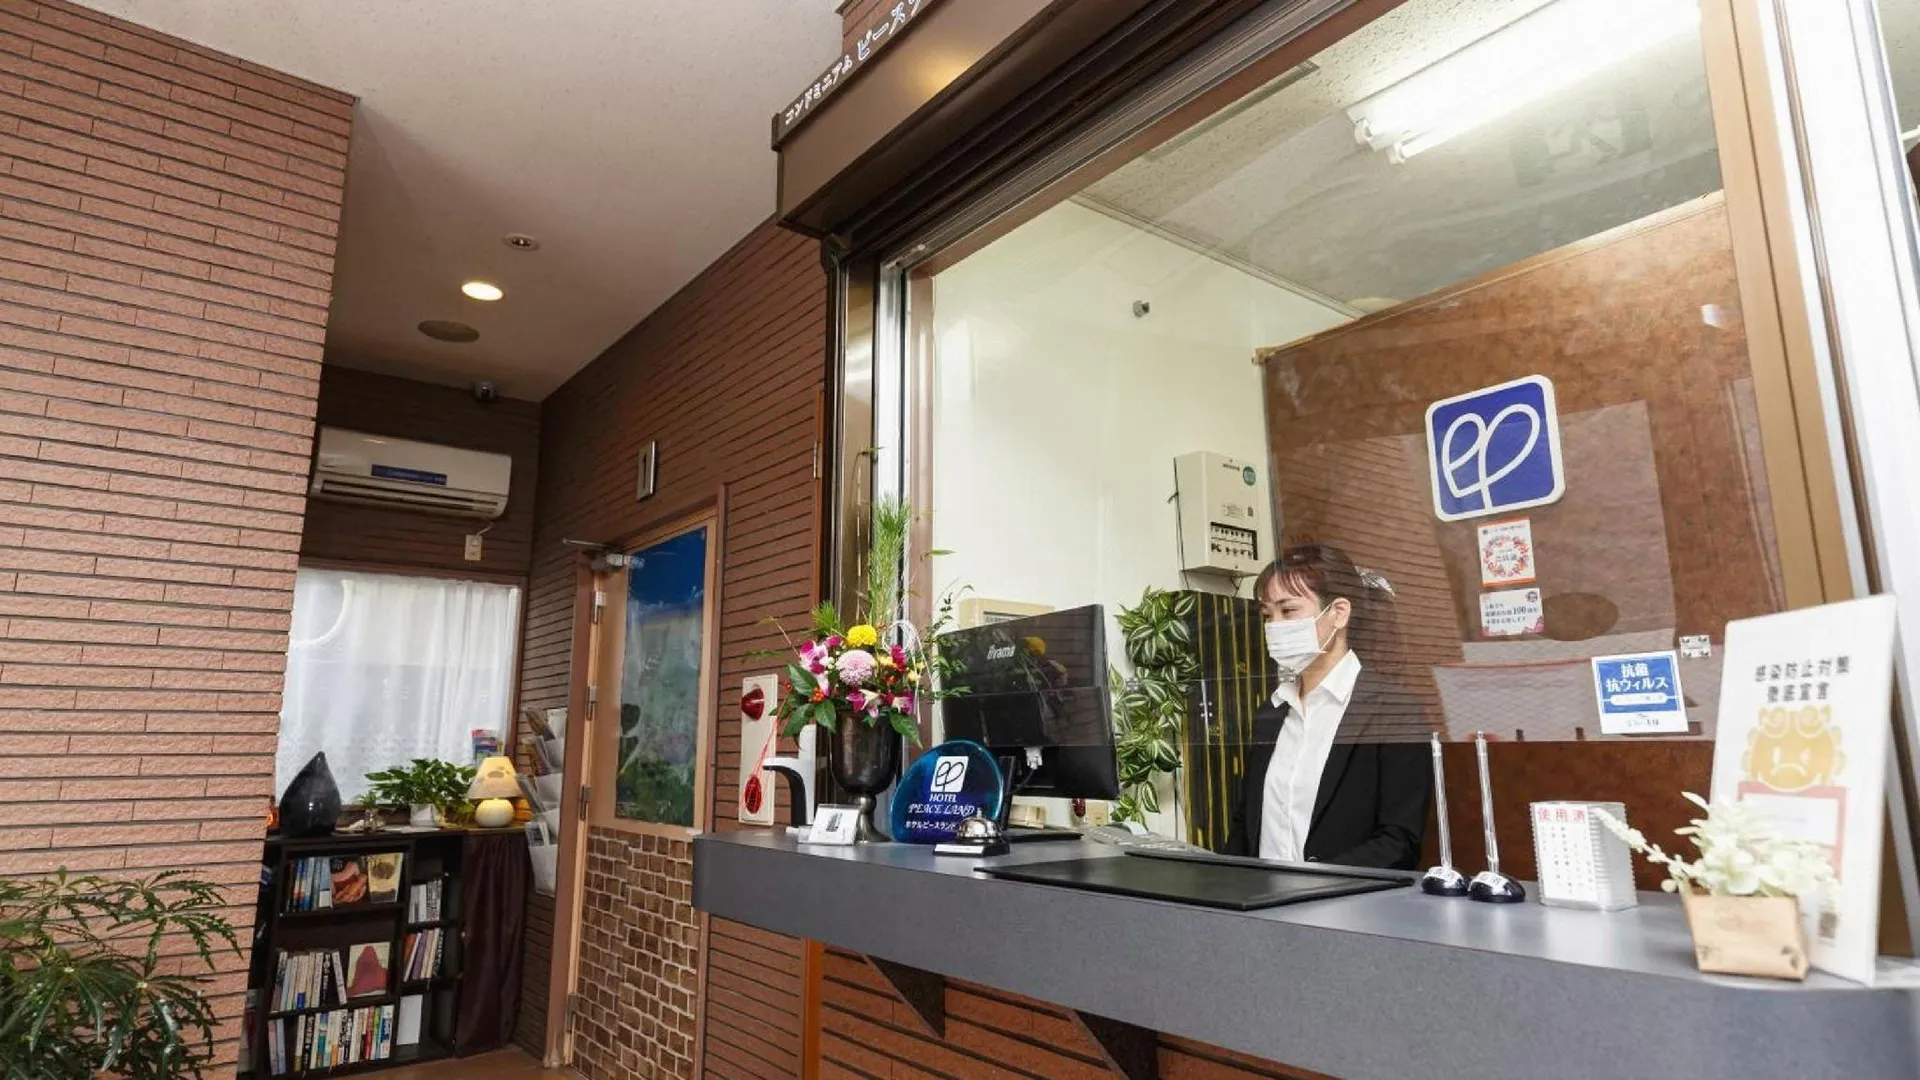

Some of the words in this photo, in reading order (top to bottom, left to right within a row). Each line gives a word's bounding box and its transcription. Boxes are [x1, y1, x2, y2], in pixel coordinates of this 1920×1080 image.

[785, 54, 853, 126] コンドミニアム
[1620, 662, 1650, 678] 抗菌
[1605, 676, 1669, 693] 抗ウィルス
[929, 793, 957, 803] HOTEL
[907, 803, 942, 815] PEACE
[943, 804, 975, 817] LAND
[905, 820, 957, 832] ホテルピースランド
